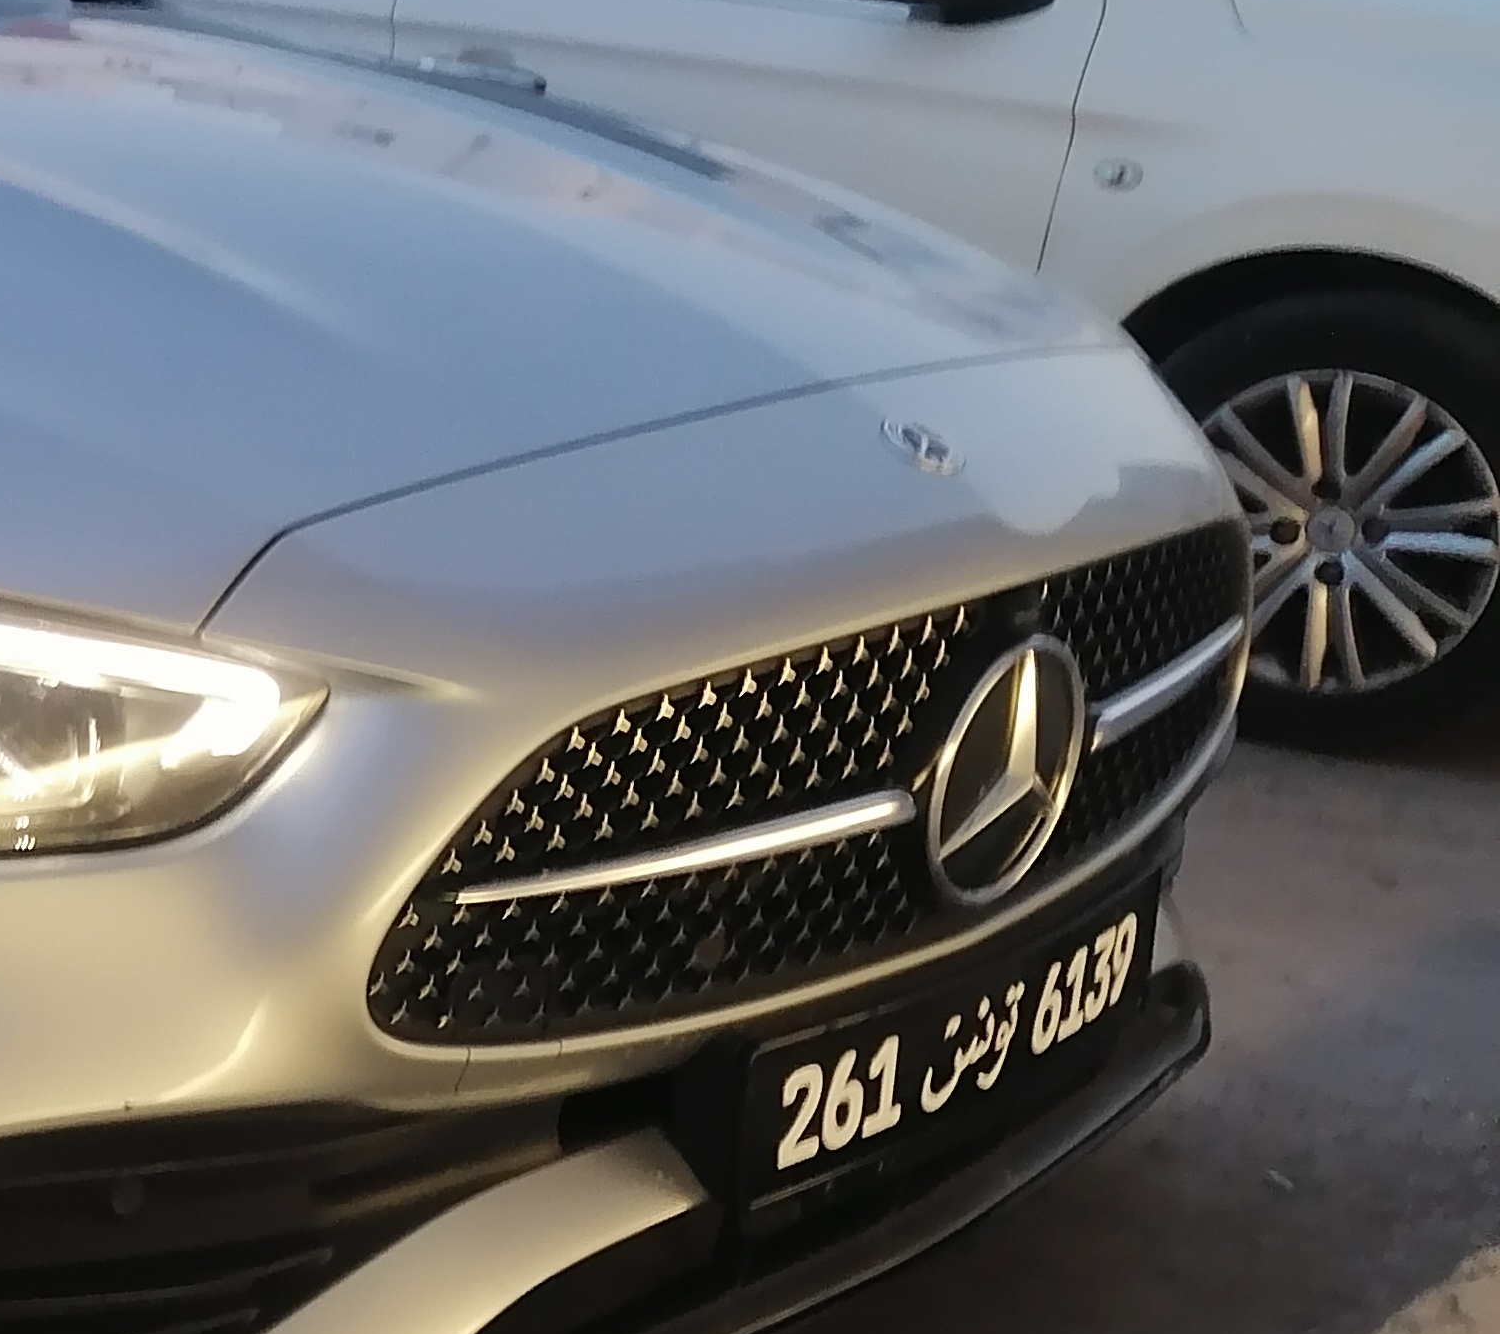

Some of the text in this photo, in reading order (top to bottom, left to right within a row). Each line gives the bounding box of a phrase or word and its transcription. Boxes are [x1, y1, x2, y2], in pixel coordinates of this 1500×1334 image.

[777, 912, 1138, 1170] 261 تونس 6139
